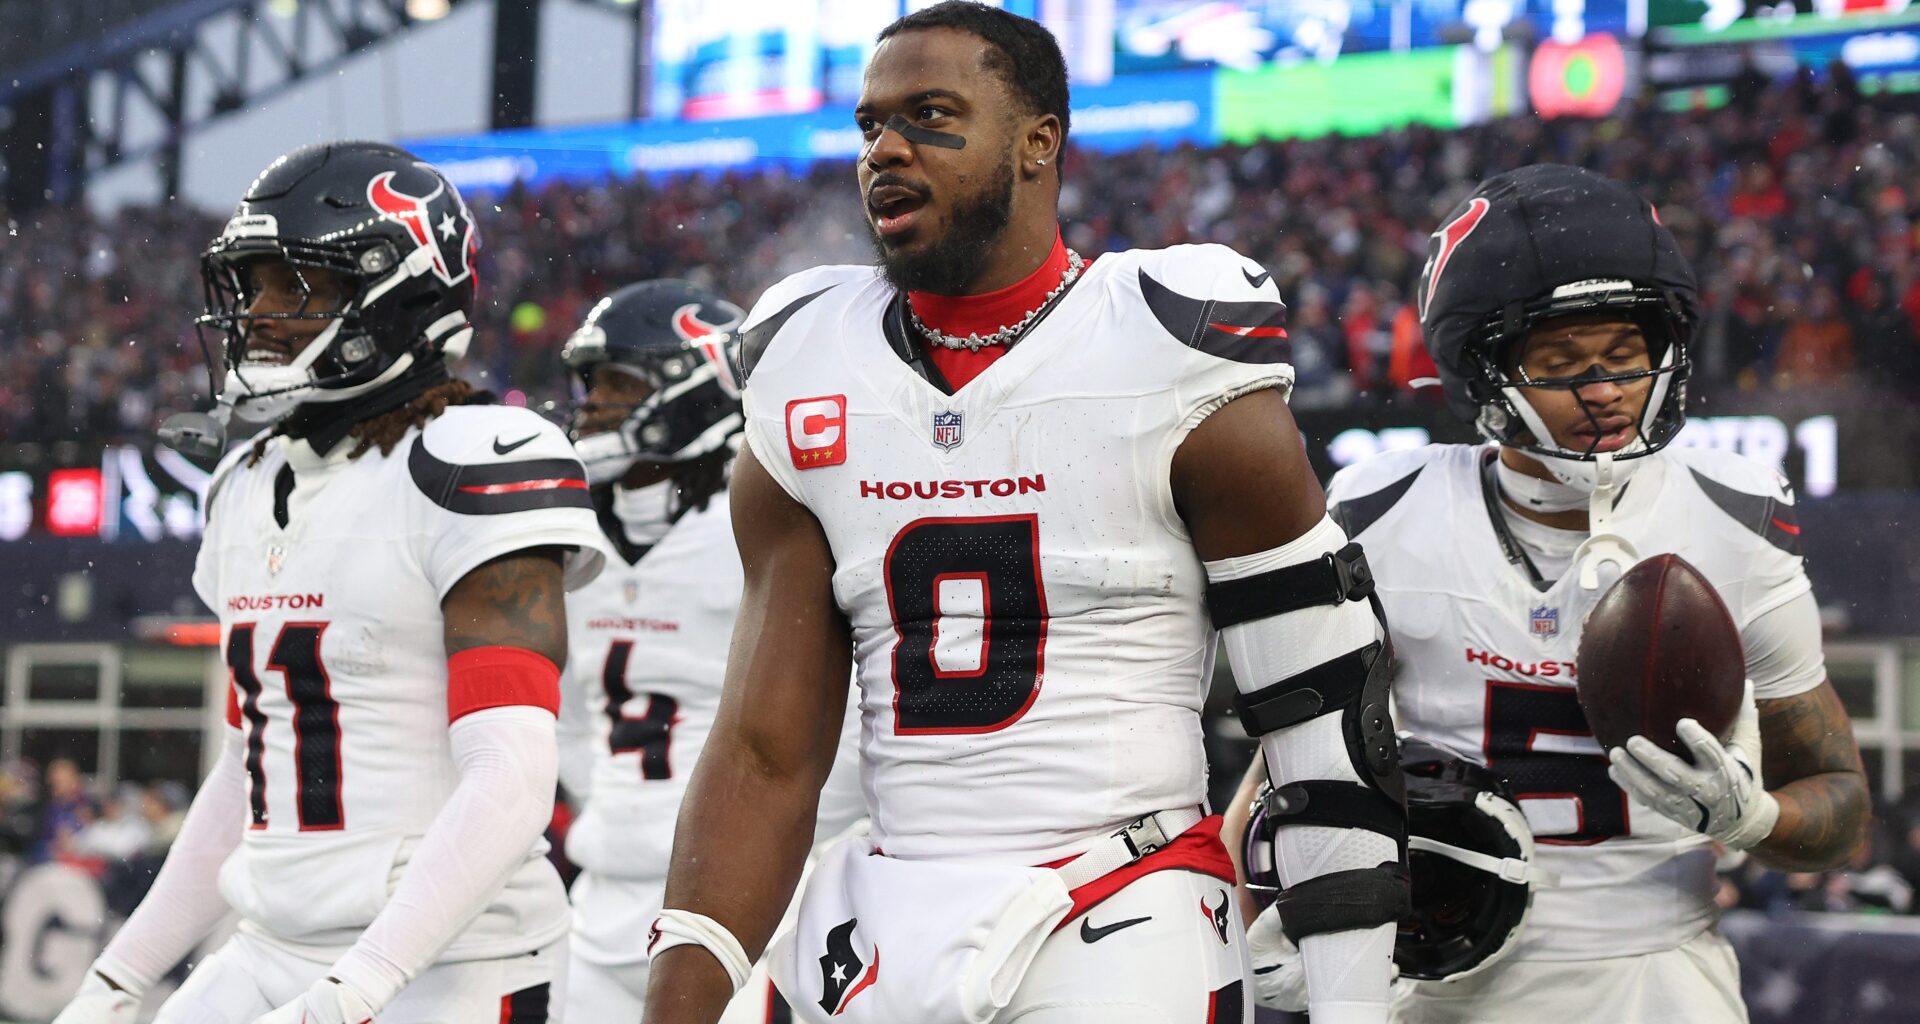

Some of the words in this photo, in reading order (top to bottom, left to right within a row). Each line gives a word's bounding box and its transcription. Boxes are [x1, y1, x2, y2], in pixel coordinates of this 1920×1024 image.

[789, 399, 840, 450] C
[935, 426, 959, 446] NFL
[860, 474, 1046, 500] HOUSTON
[228, 593, 323, 611] HOUSTON
[883, 513, 1050, 736] 0
[1465, 648, 1578, 678] HOUST
[226, 620, 345, 832] 11
[603, 638, 678, 781] 4
[1483, 680, 1631, 847] 5
